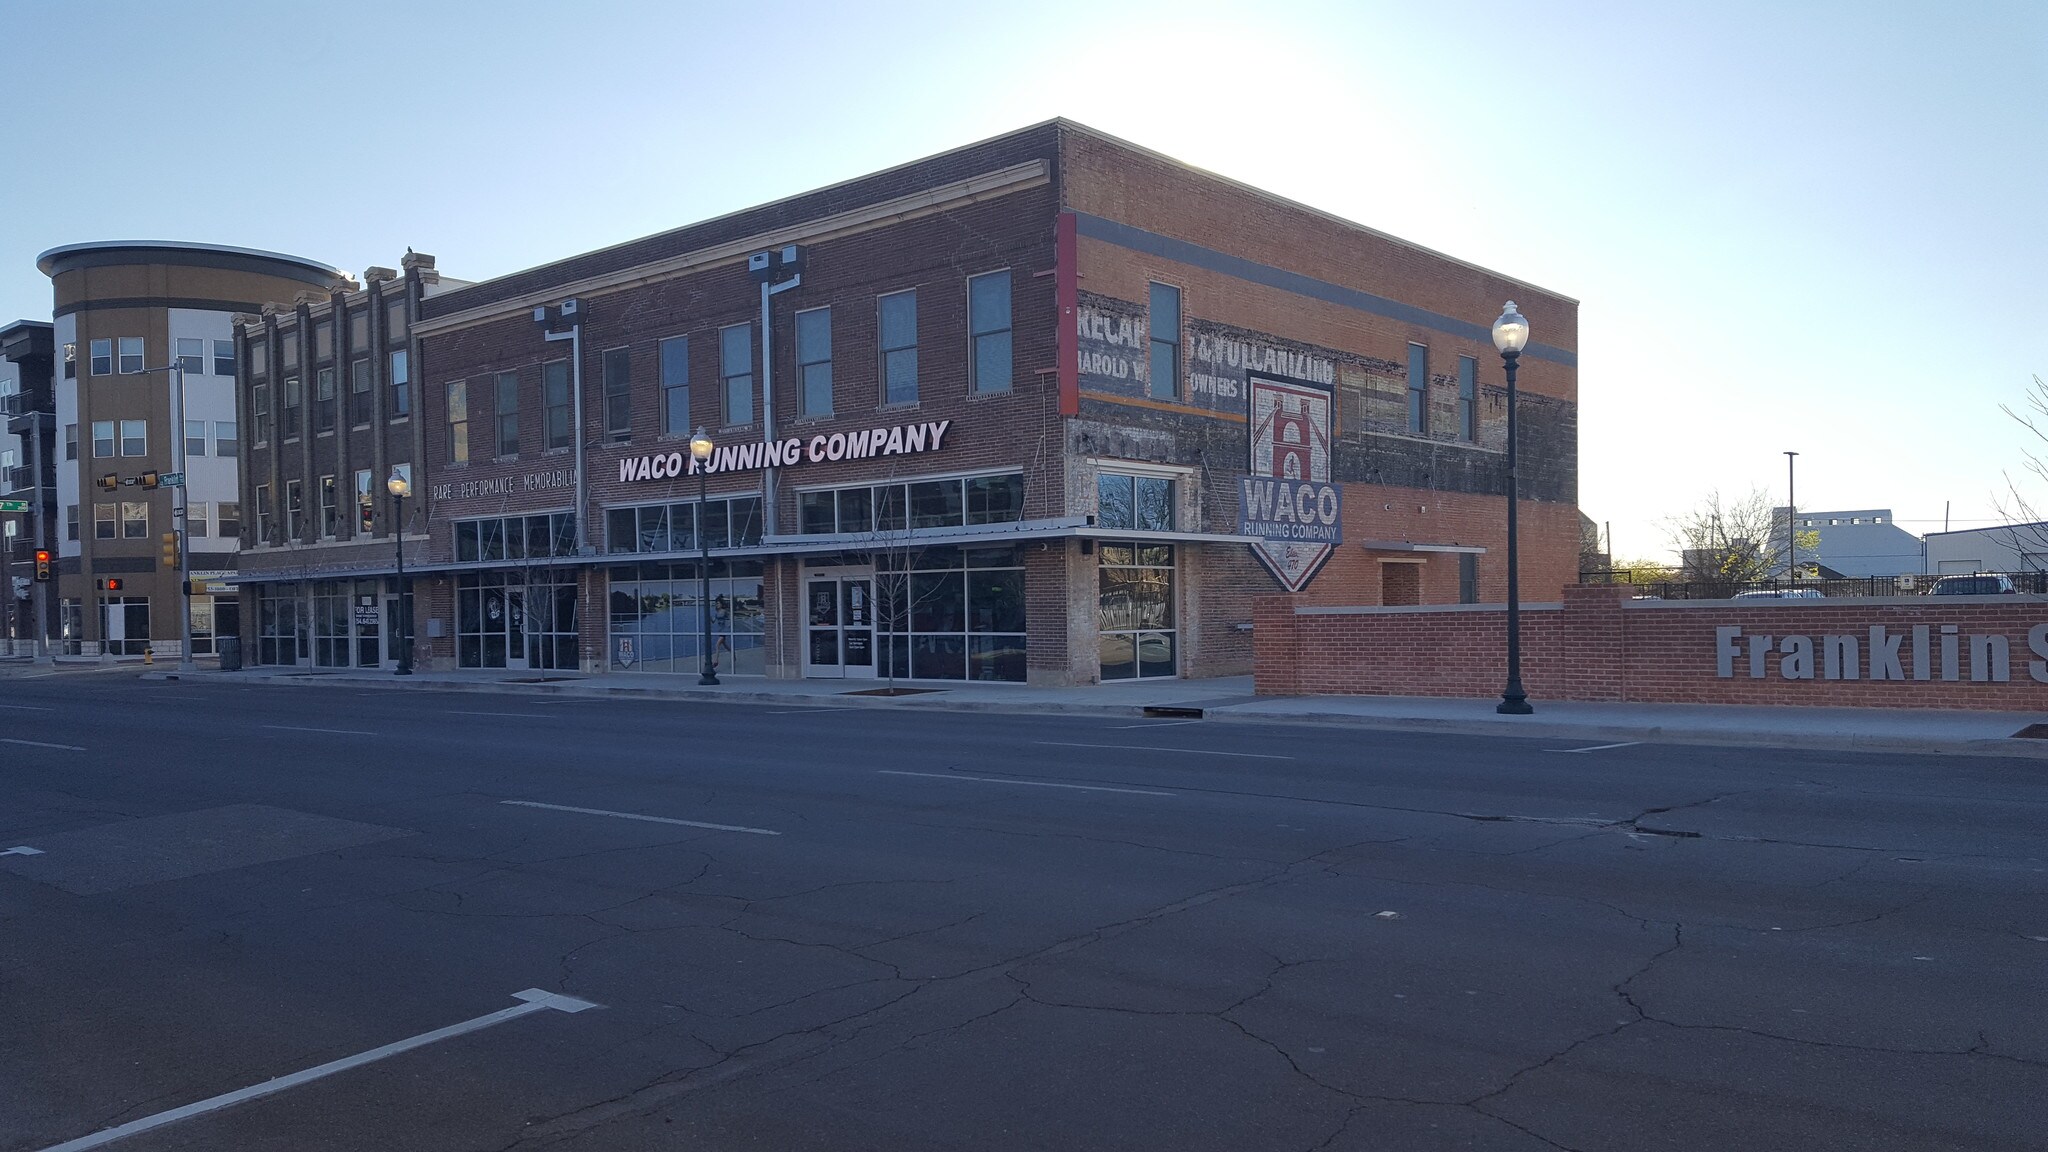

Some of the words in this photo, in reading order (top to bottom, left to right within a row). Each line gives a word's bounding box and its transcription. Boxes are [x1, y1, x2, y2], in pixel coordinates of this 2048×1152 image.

[1190, 372, 1237, 397] OWNERS
[619, 452, 683, 482] WACO
[809, 420, 950, 463] COMPANY
[433, 484, 452, 500] RARE
[461, 476, 514, 498] PERFORMANCE
[523, 469, 577, 491] MEMORABILIA
[1243, 479, 1338, 525] WACO
[1243, 522, 1290, 538] RUNNING
[1291, 524, 1337, 540] COMPANY
[1716, 624, 2011, 682] Franklin
